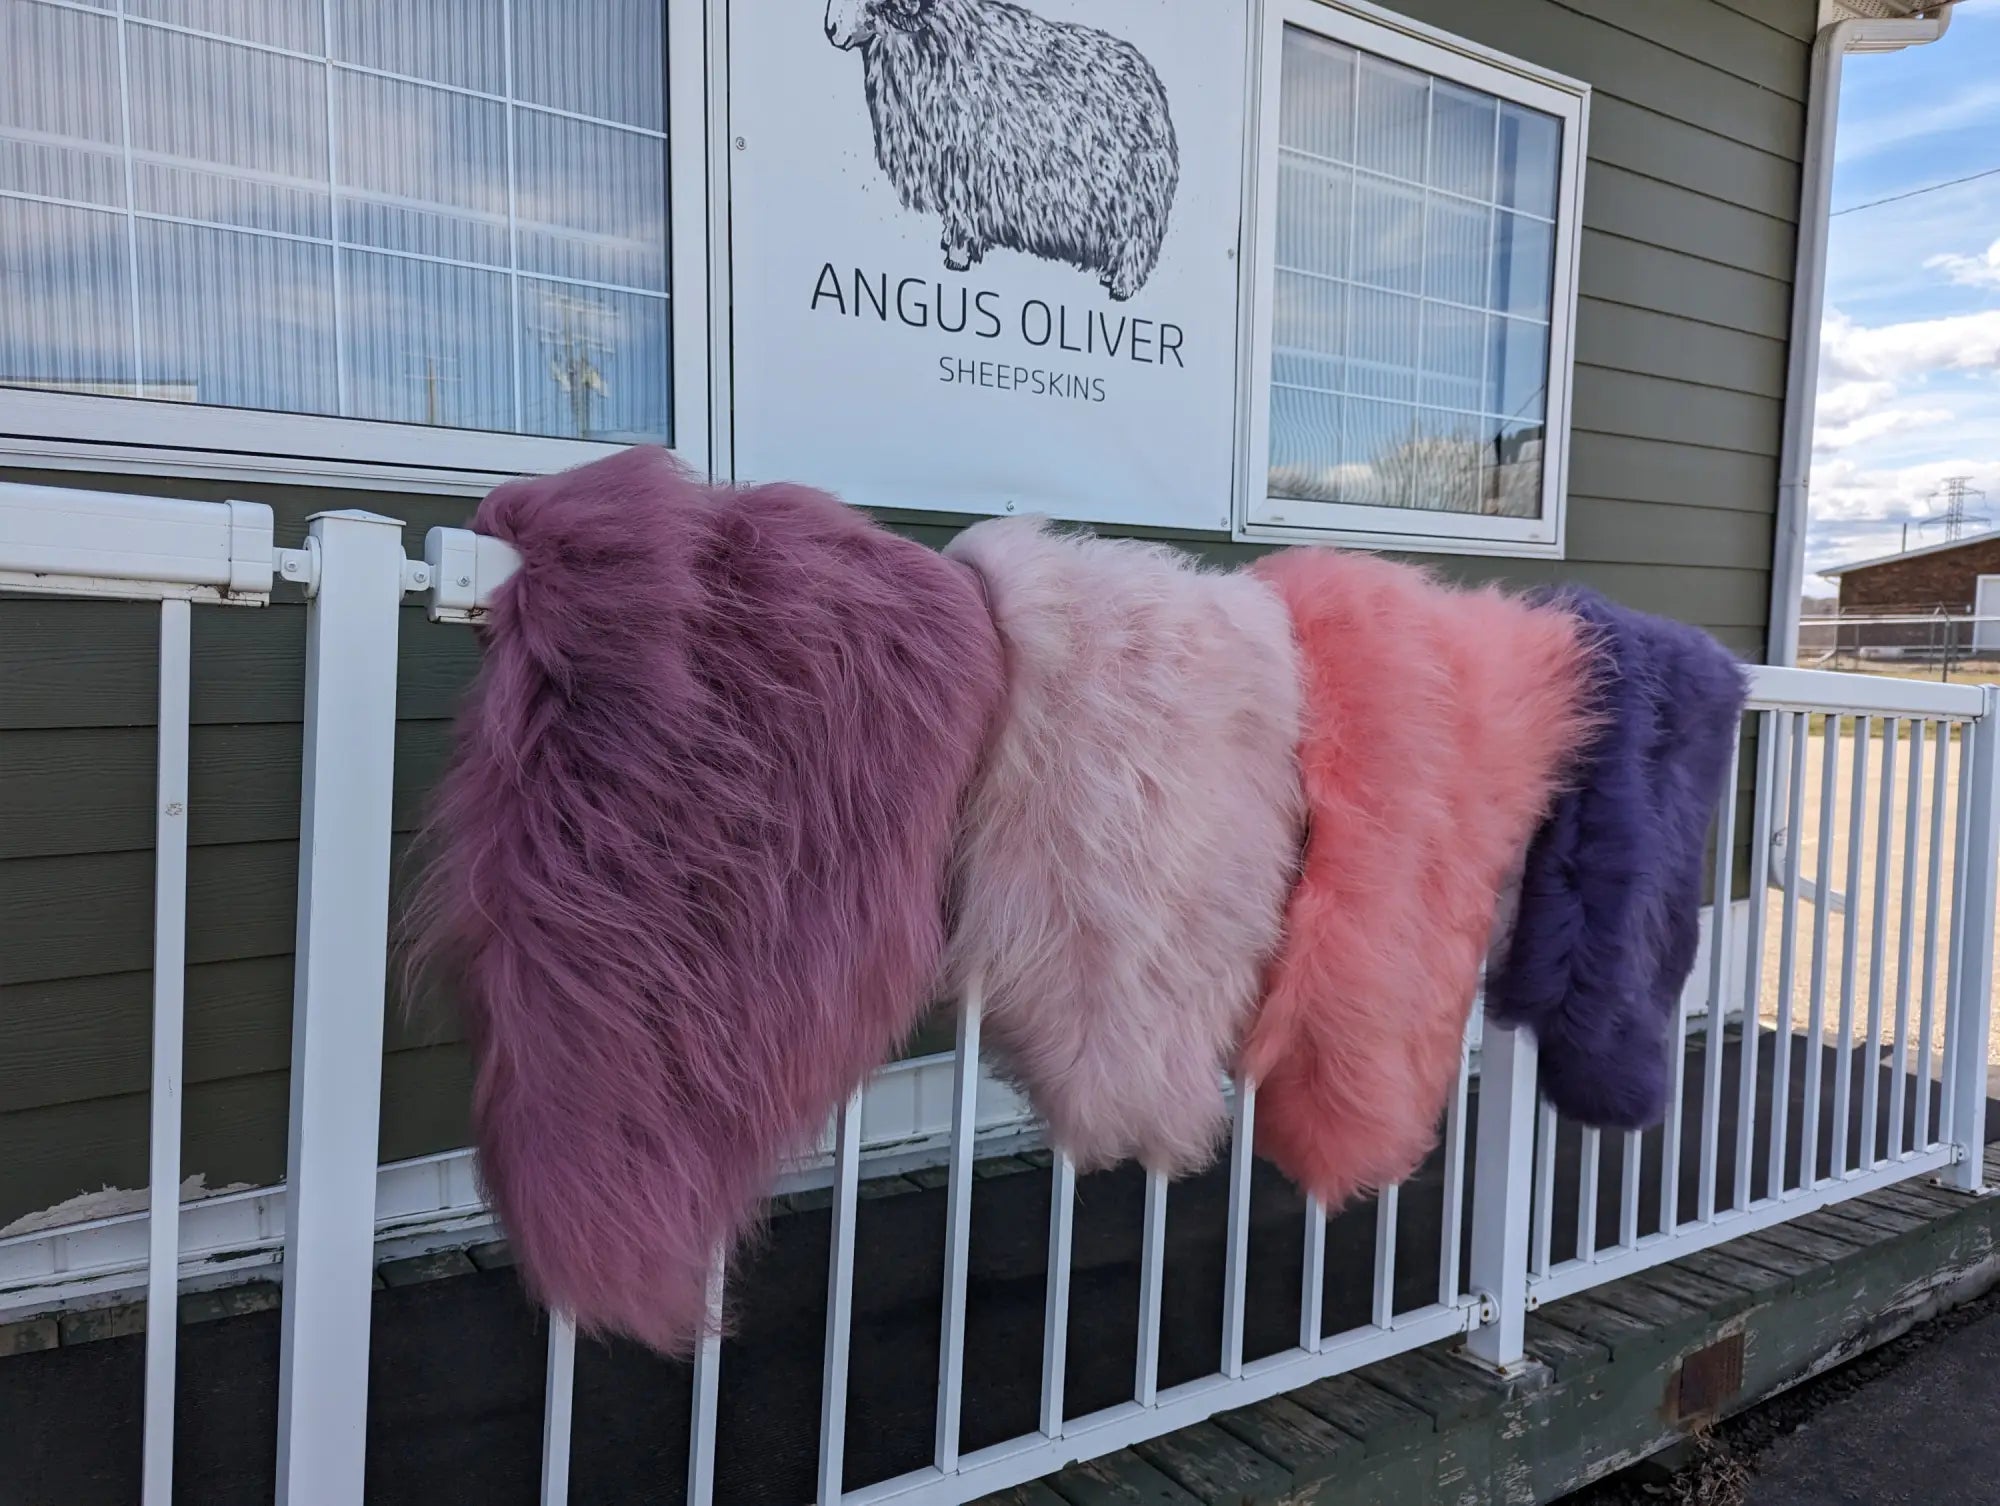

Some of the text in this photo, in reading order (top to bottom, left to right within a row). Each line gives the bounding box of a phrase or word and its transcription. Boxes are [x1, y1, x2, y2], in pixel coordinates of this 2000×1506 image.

[811, 262, 1185, 368] ANGUS OLIVER
[939, 356, 1106, 403] SHEEPSKINS
